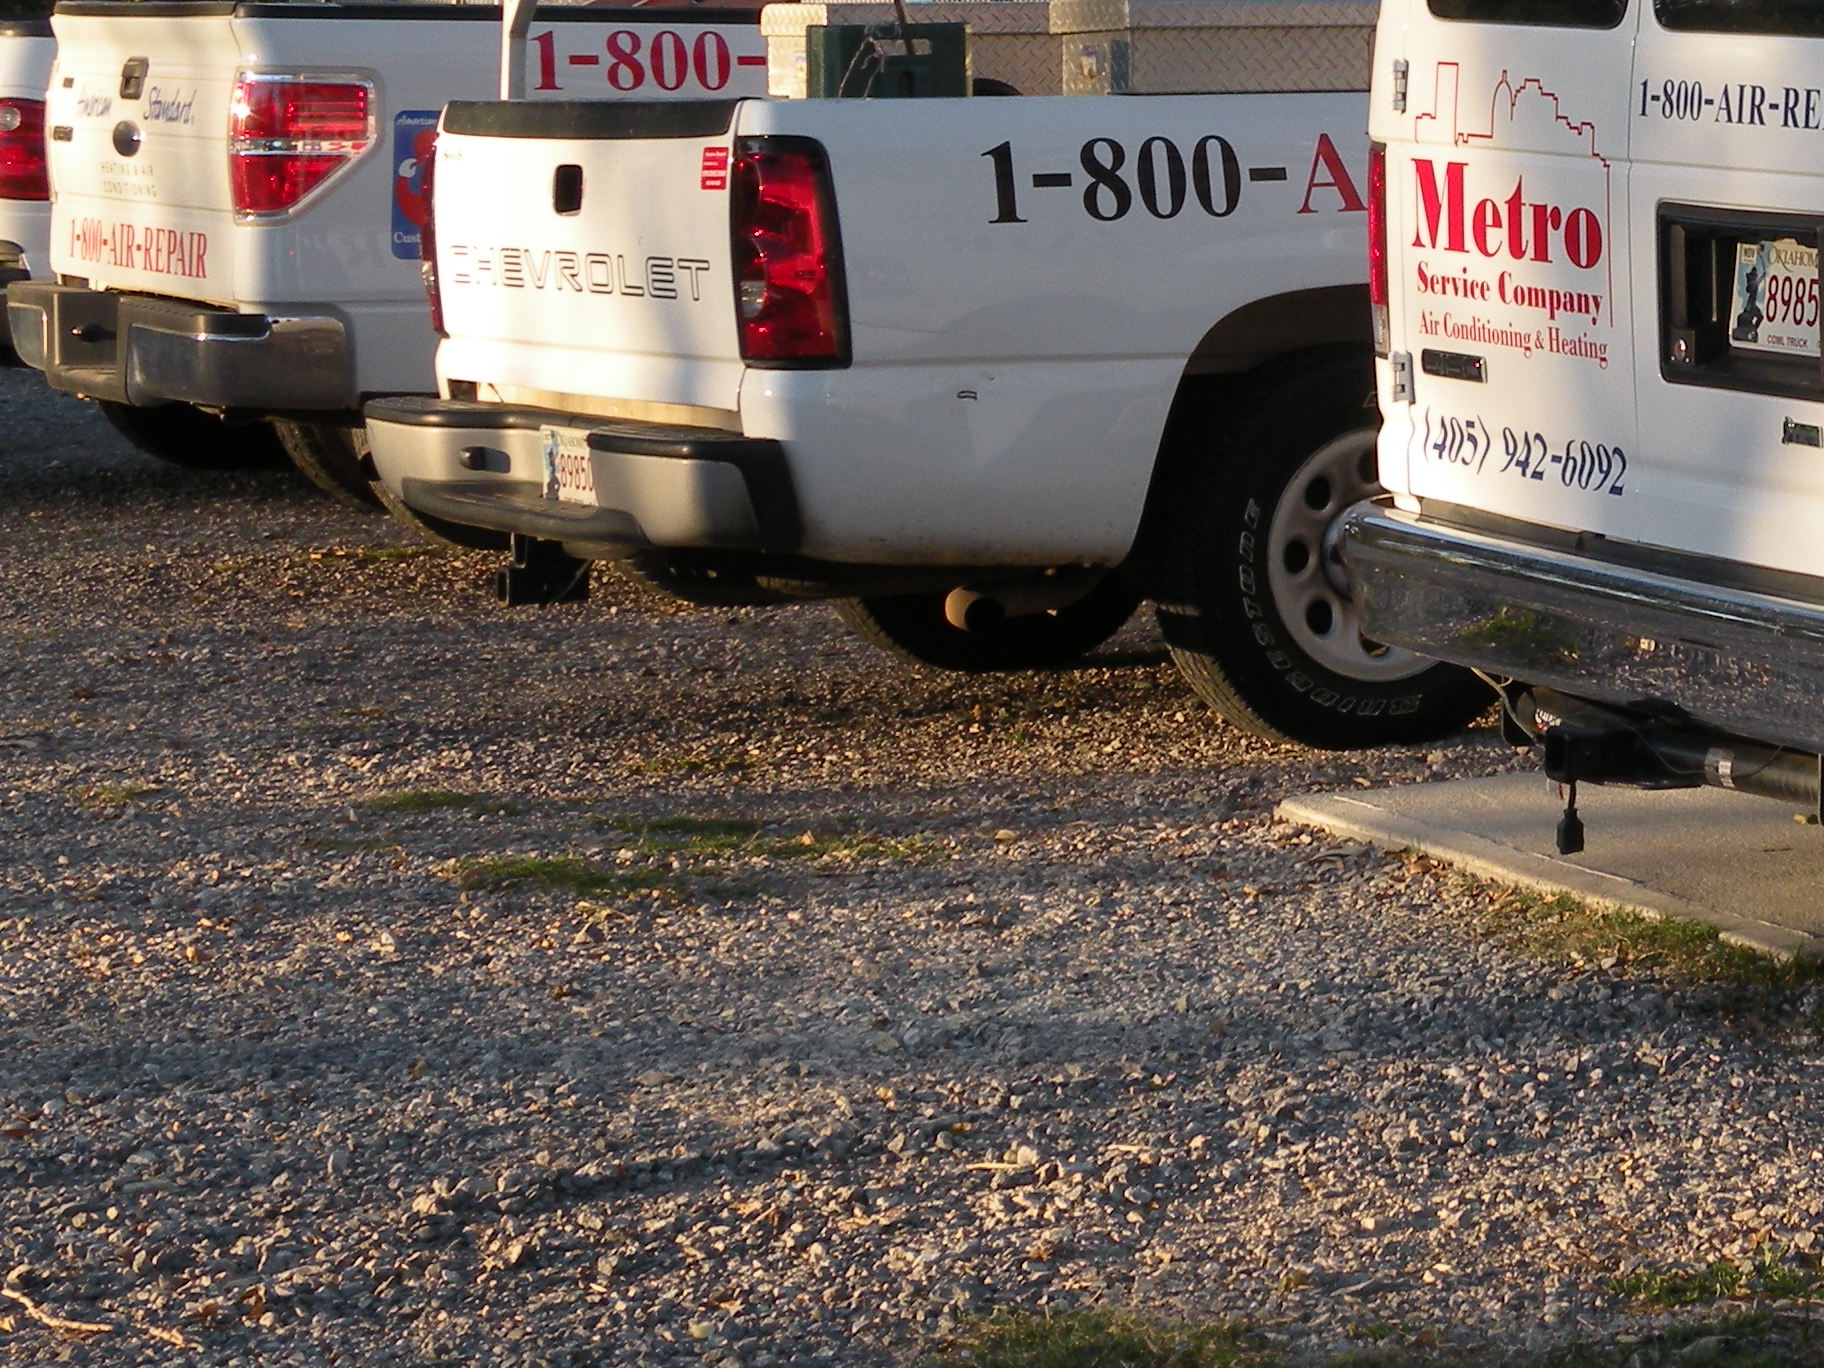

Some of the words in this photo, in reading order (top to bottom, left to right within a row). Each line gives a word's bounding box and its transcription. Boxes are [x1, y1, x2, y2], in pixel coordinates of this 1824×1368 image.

[530, 29, 767, 91] 1-800-
[980, 133, 1369, 224] 1-800-A
[1411, 158, 1602, 269] Metro
[69, 218, 208, 279] 1-800-AIR-REPAIR
[451, 244, 710, 301] CHEVROLET
[1417, 260, 1491, 301] Service
[1498, 270, 1603, 326] Company
[1419, 308, 1441, 336] Air
[1443, 311, 1532, 359] Conditioning
[1534, 330, 1545, 350] &
[1547, 326, 1609, 370] Heating
[1423, 405, 1491, 475] (405)
[1500, 427, 1627, 496] 942-6092
